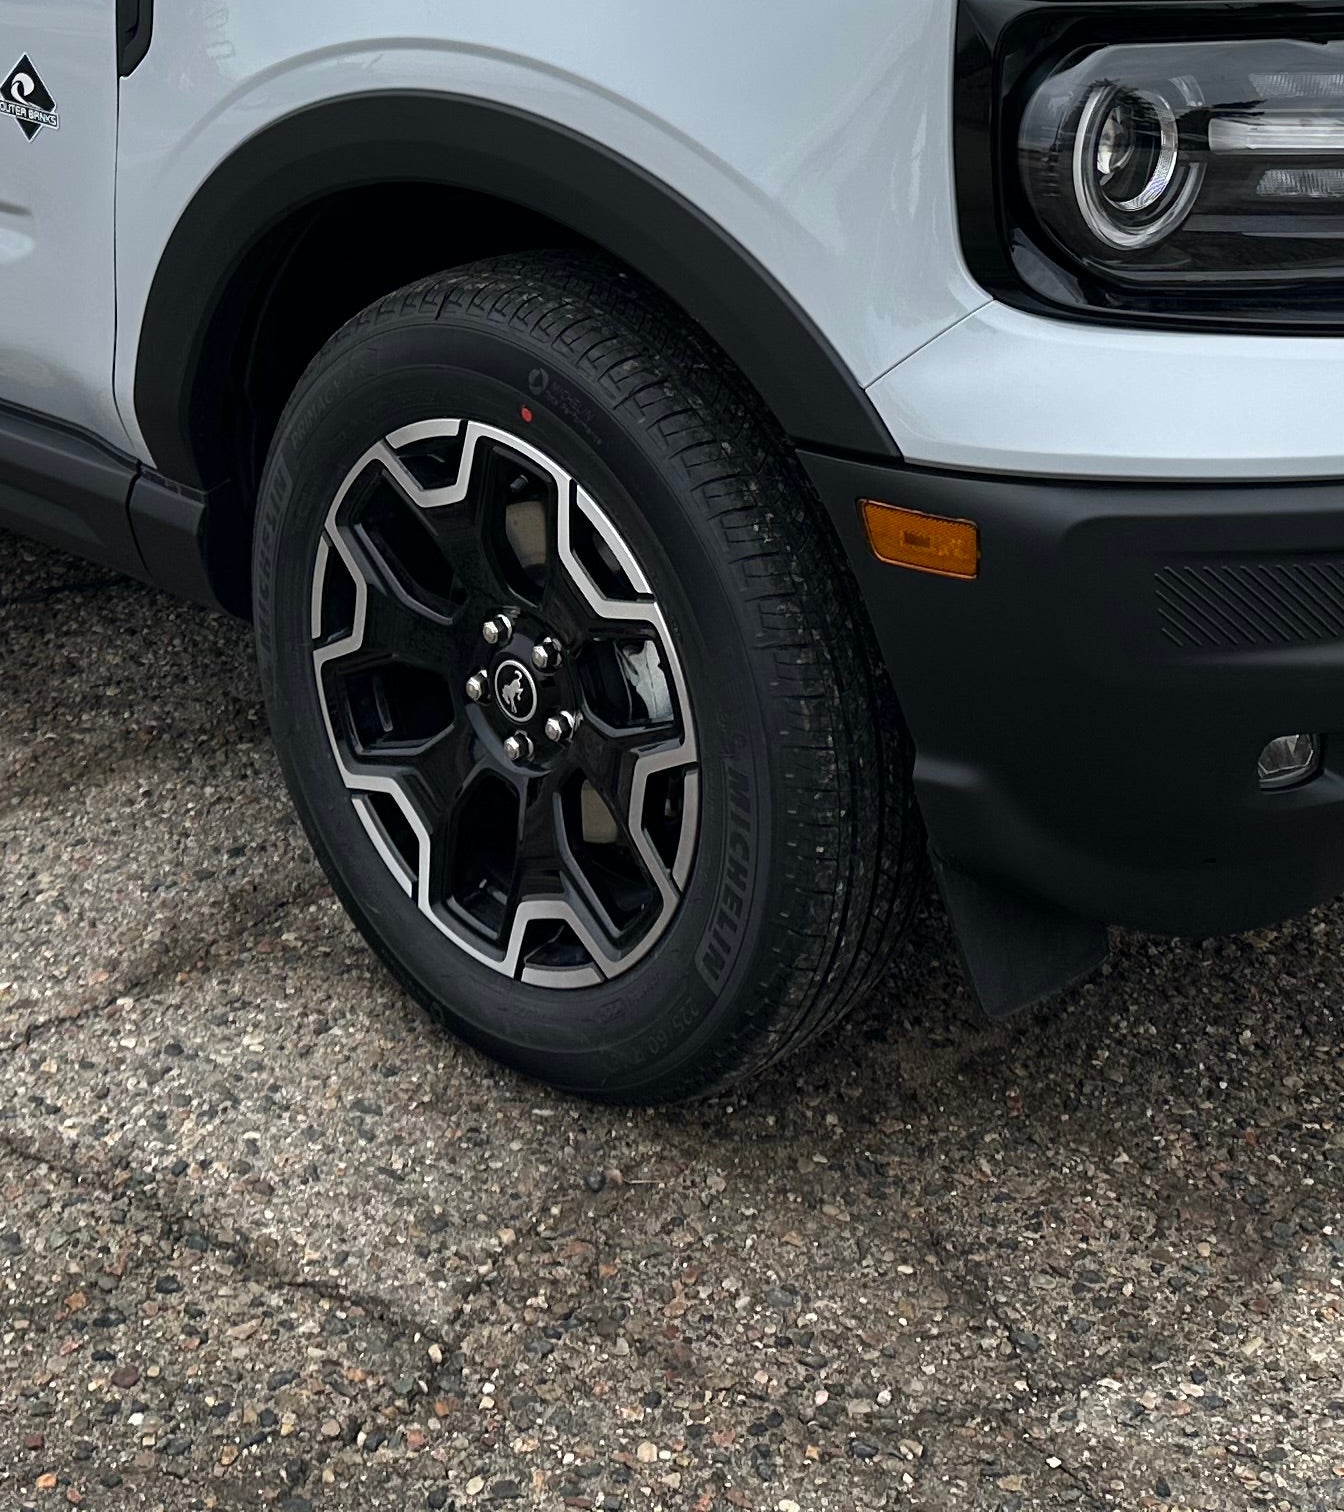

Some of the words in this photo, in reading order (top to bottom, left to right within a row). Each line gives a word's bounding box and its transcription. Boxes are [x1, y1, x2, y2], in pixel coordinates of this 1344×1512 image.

[0, 101, 27, 118] OUTER
[28, 109, 57, 126] BANKS
[256, 465, 288, 656] MICHELIN
[701, 767, 752, 982] MICHELIN
